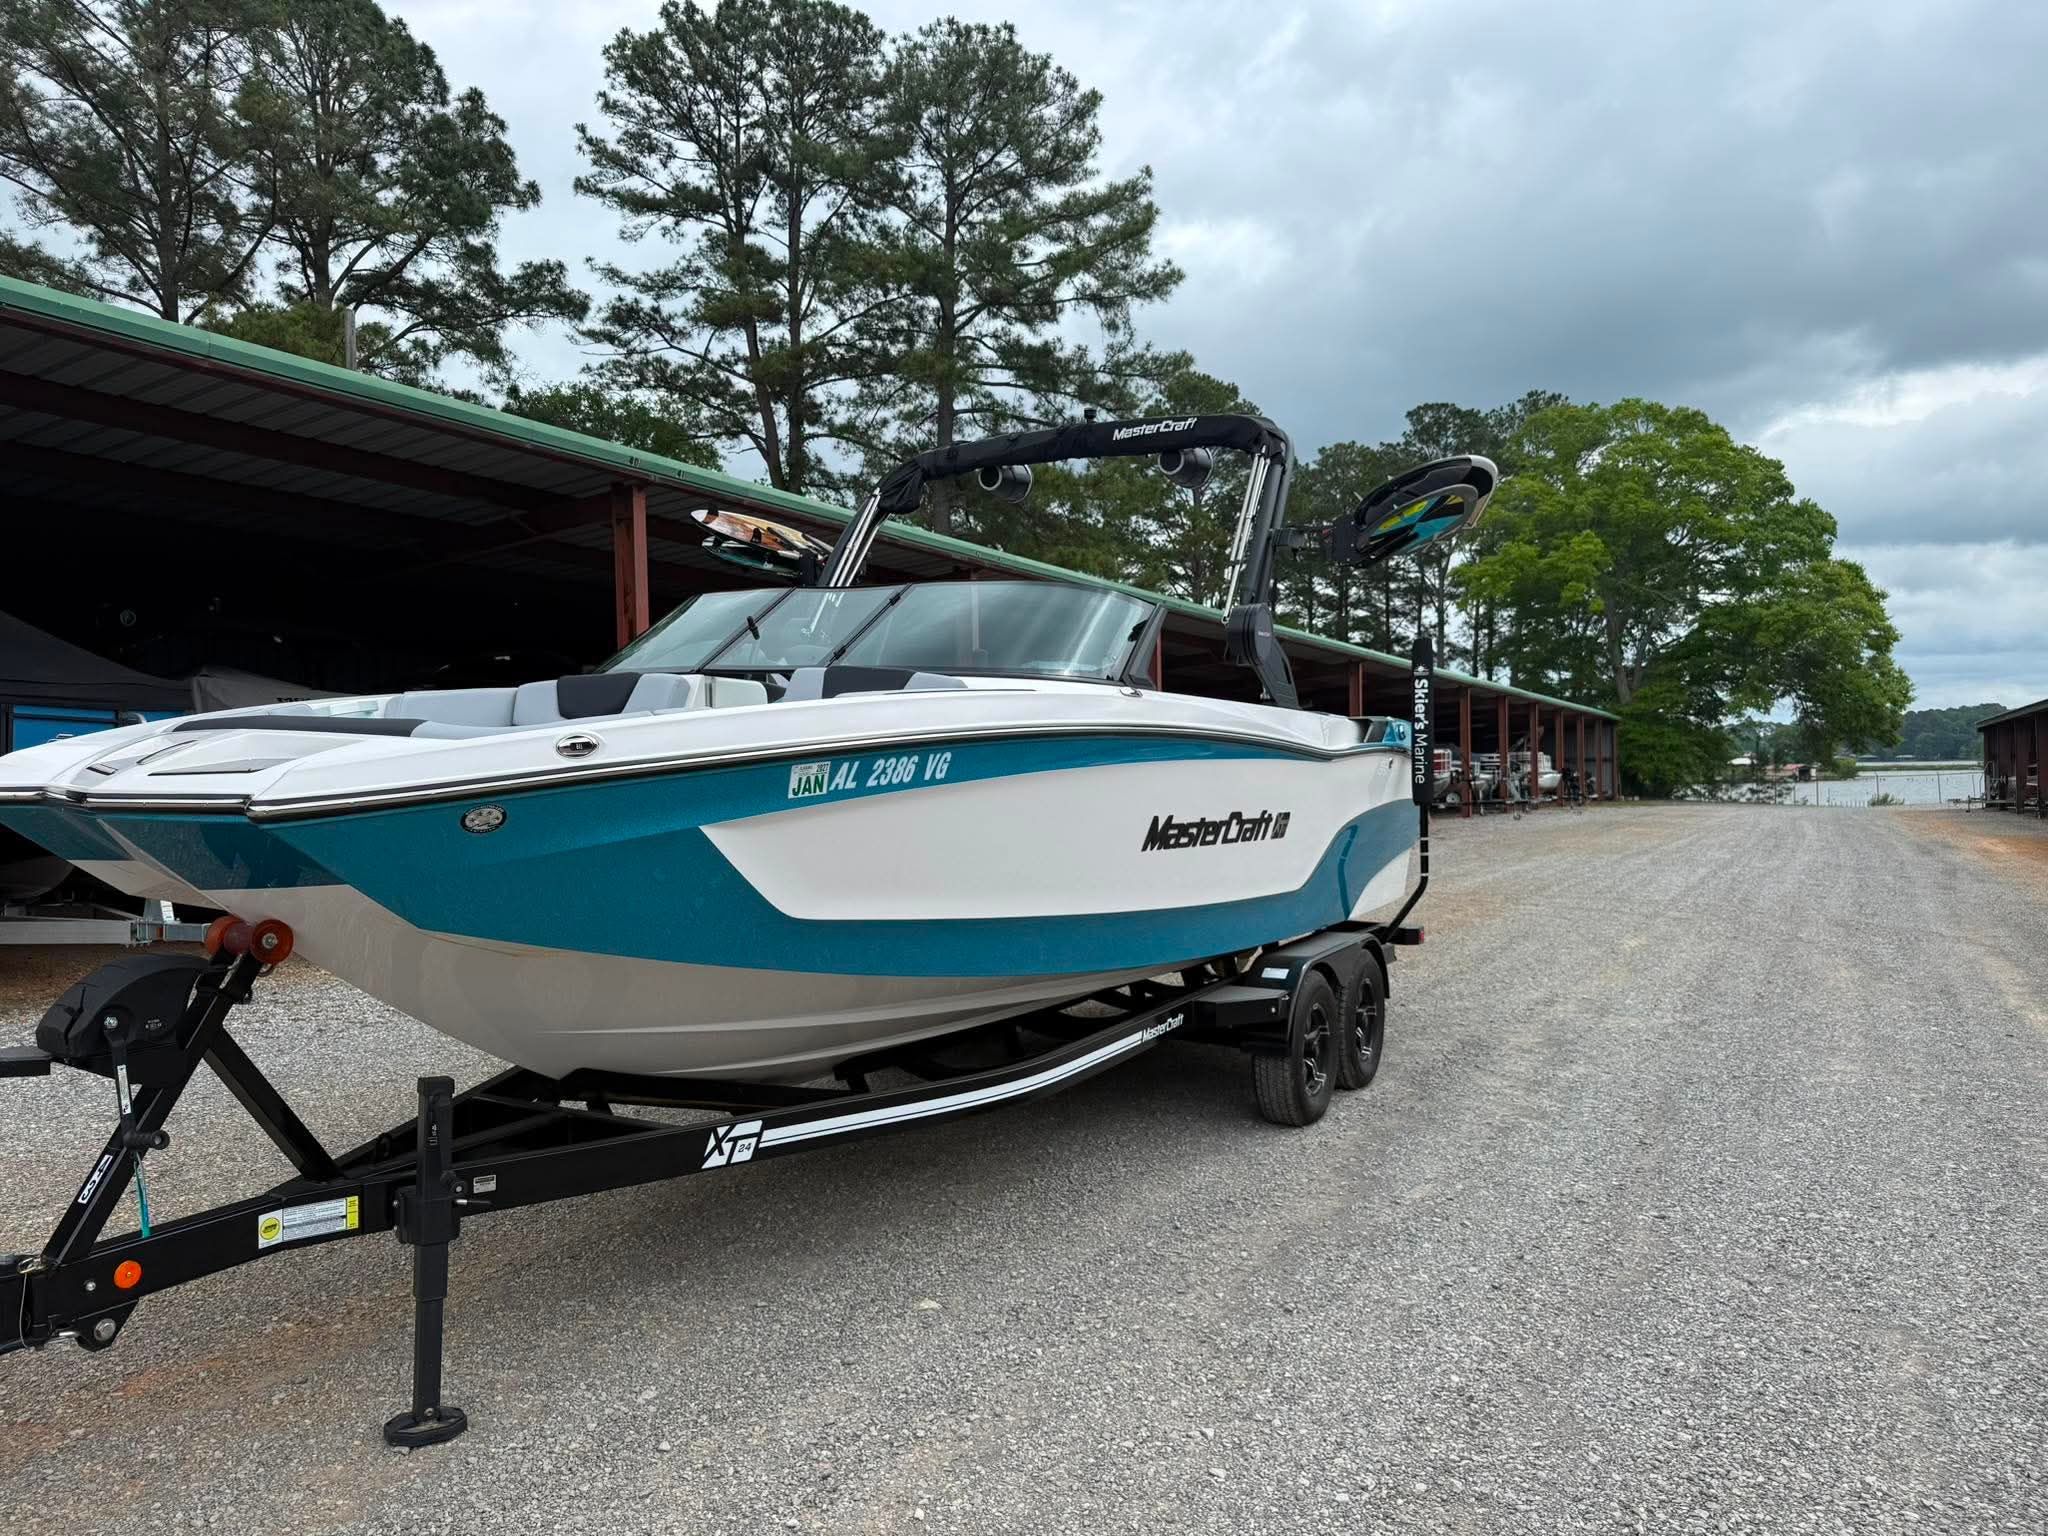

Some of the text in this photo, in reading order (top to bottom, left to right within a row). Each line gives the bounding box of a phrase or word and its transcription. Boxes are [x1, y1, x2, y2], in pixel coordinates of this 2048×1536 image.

[1113, 417, 1197, 440] MasterCraft
[1414, 678, 1429, 784] Skier's Marine
[792, 775, 824, 797] JAN
[829, 752, 952, 791] AL 2386 VG
[1141, 810, 1273, 852] MasterCraft
[1143, 1013, 1184, 1042] MasterCraft
[701, 1121, 761, 1166] XT
[738, 1142, 752, 1153] 24
